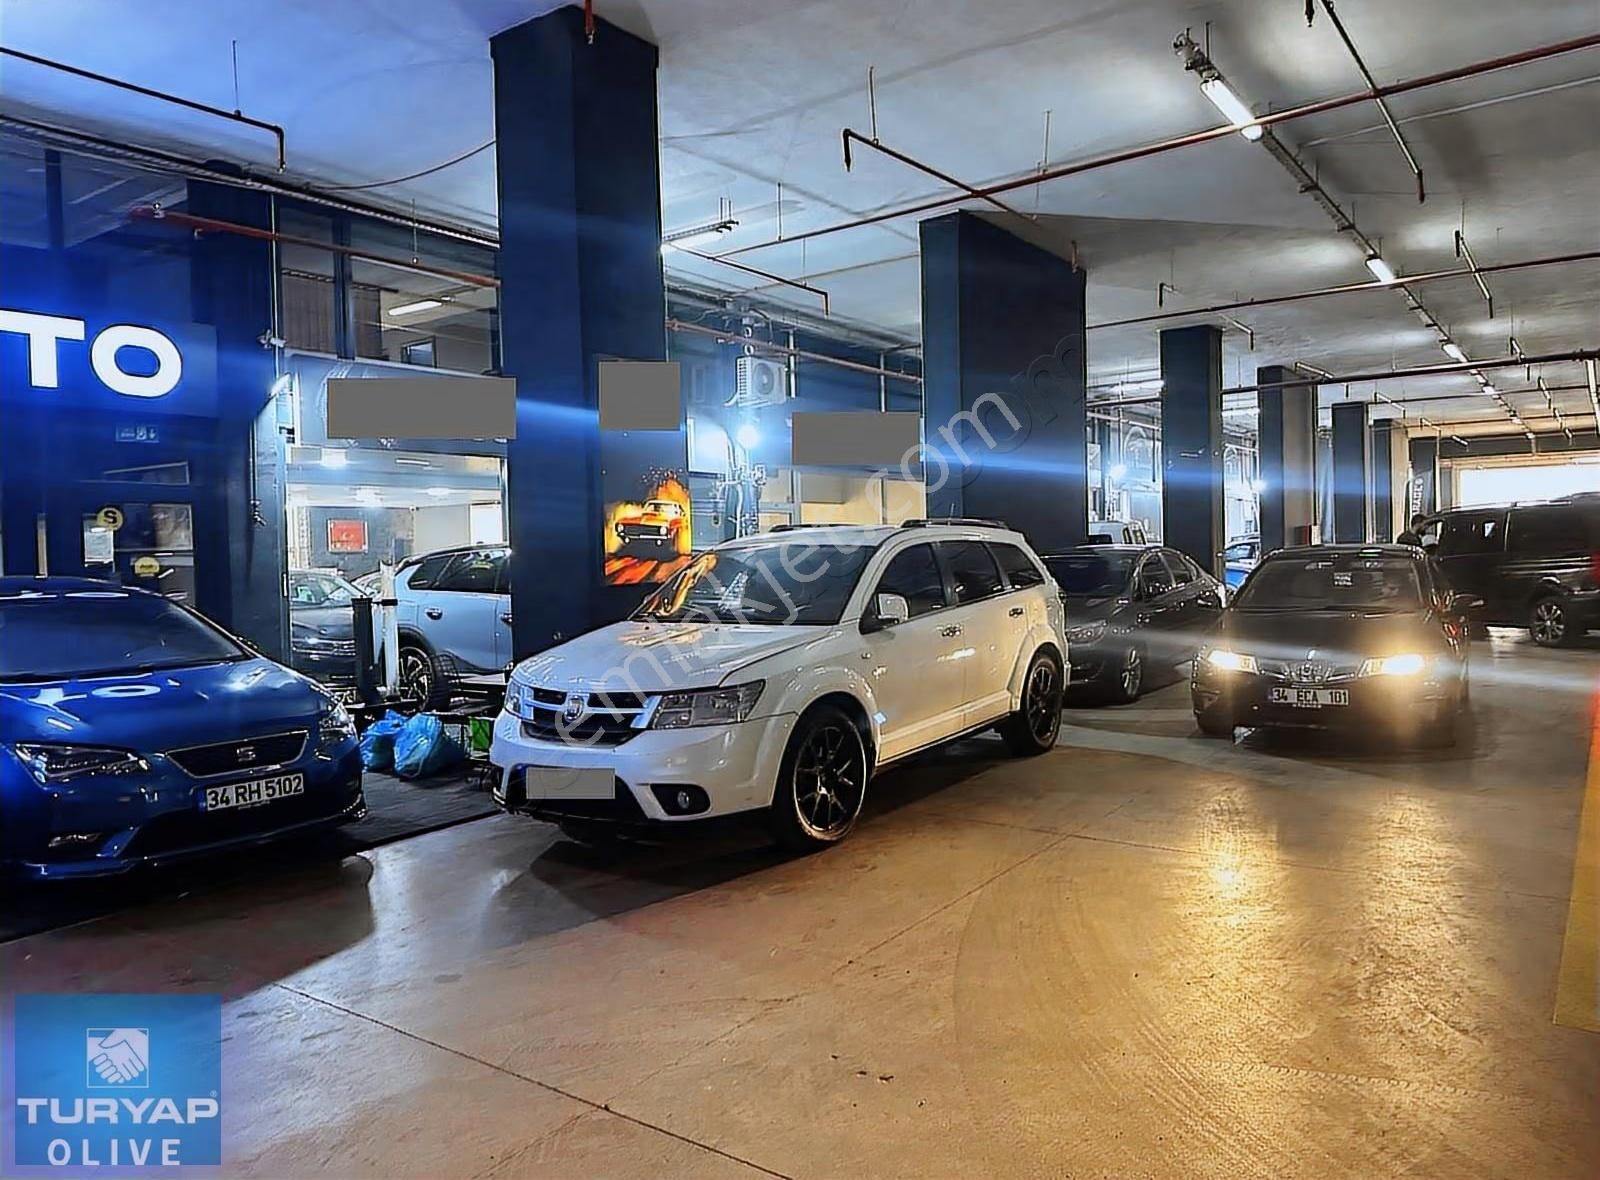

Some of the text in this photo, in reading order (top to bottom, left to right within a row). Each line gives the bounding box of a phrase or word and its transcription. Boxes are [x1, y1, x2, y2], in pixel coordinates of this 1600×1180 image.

[1274, 689, 1288, 701] 34
[1329, 691, 1347, 703] 101
[208, 788, 229, 808] 34
[234, 781, 261, 804] RH
[264, 776, 303, 798] 5102
